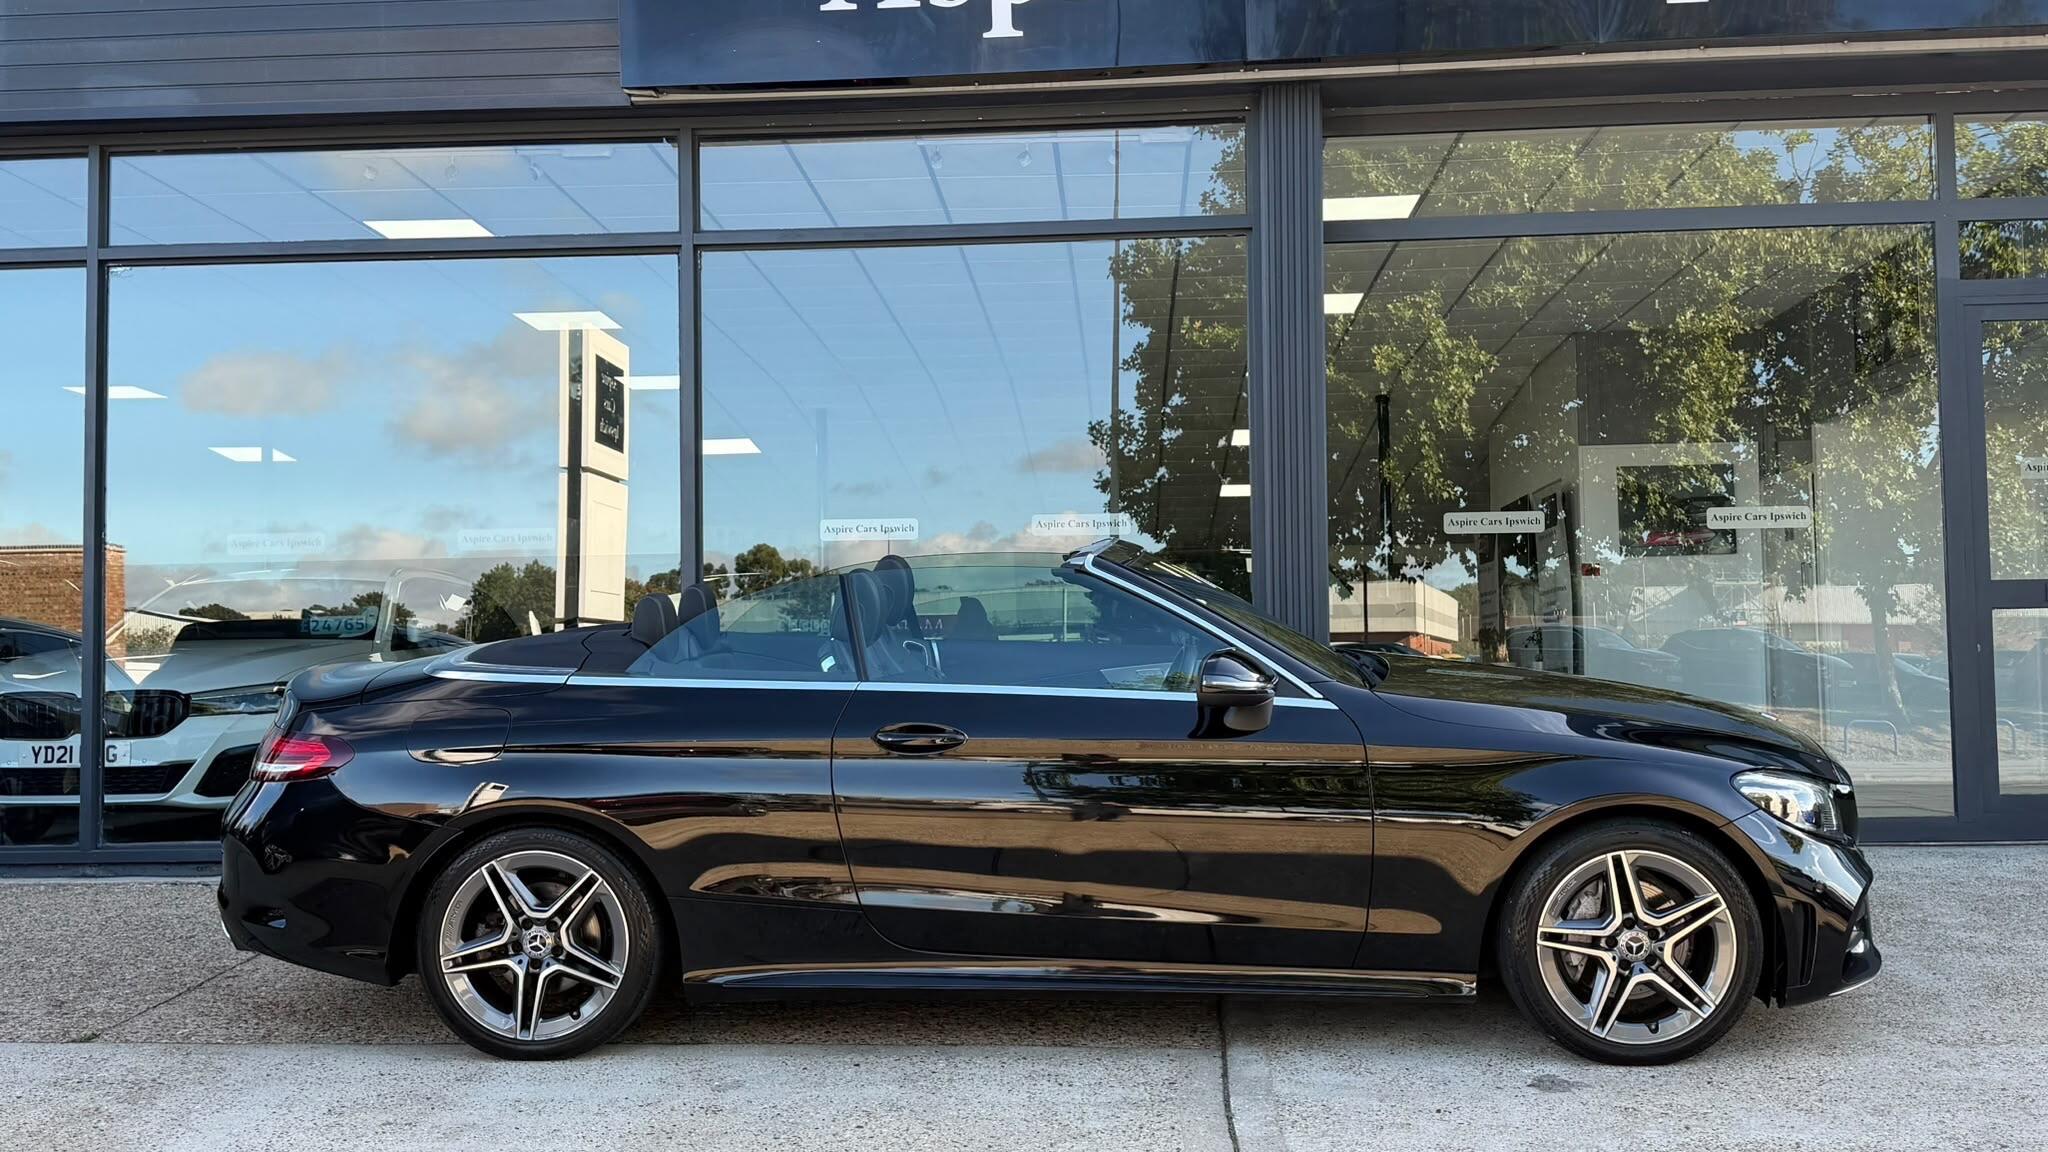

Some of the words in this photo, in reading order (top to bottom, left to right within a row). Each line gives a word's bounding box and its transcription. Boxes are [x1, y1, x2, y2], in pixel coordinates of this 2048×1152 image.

[1448, 517, 1478, 528] Aspire
[1480, 517, 1502, 526] Cars
[1506, 516, 1541, 527] Ipswich
[1711, 513, 1742, 523] Aspire
[1745, 512, 1767, 521] Cars
[1770, 511, 1807, 522] Ipswich
[824, 525, 853, 535] Aspire
[856, 524, 877, 533] Cars
[880, 523, 914, 534] Ipswich
[1036, 519, 1065, 530] Aspire
[1068, 519, 1090, 528] Cars
[1093, 518, 1127, 529] Ipswich
[31, 745, 73, 764] YD21
